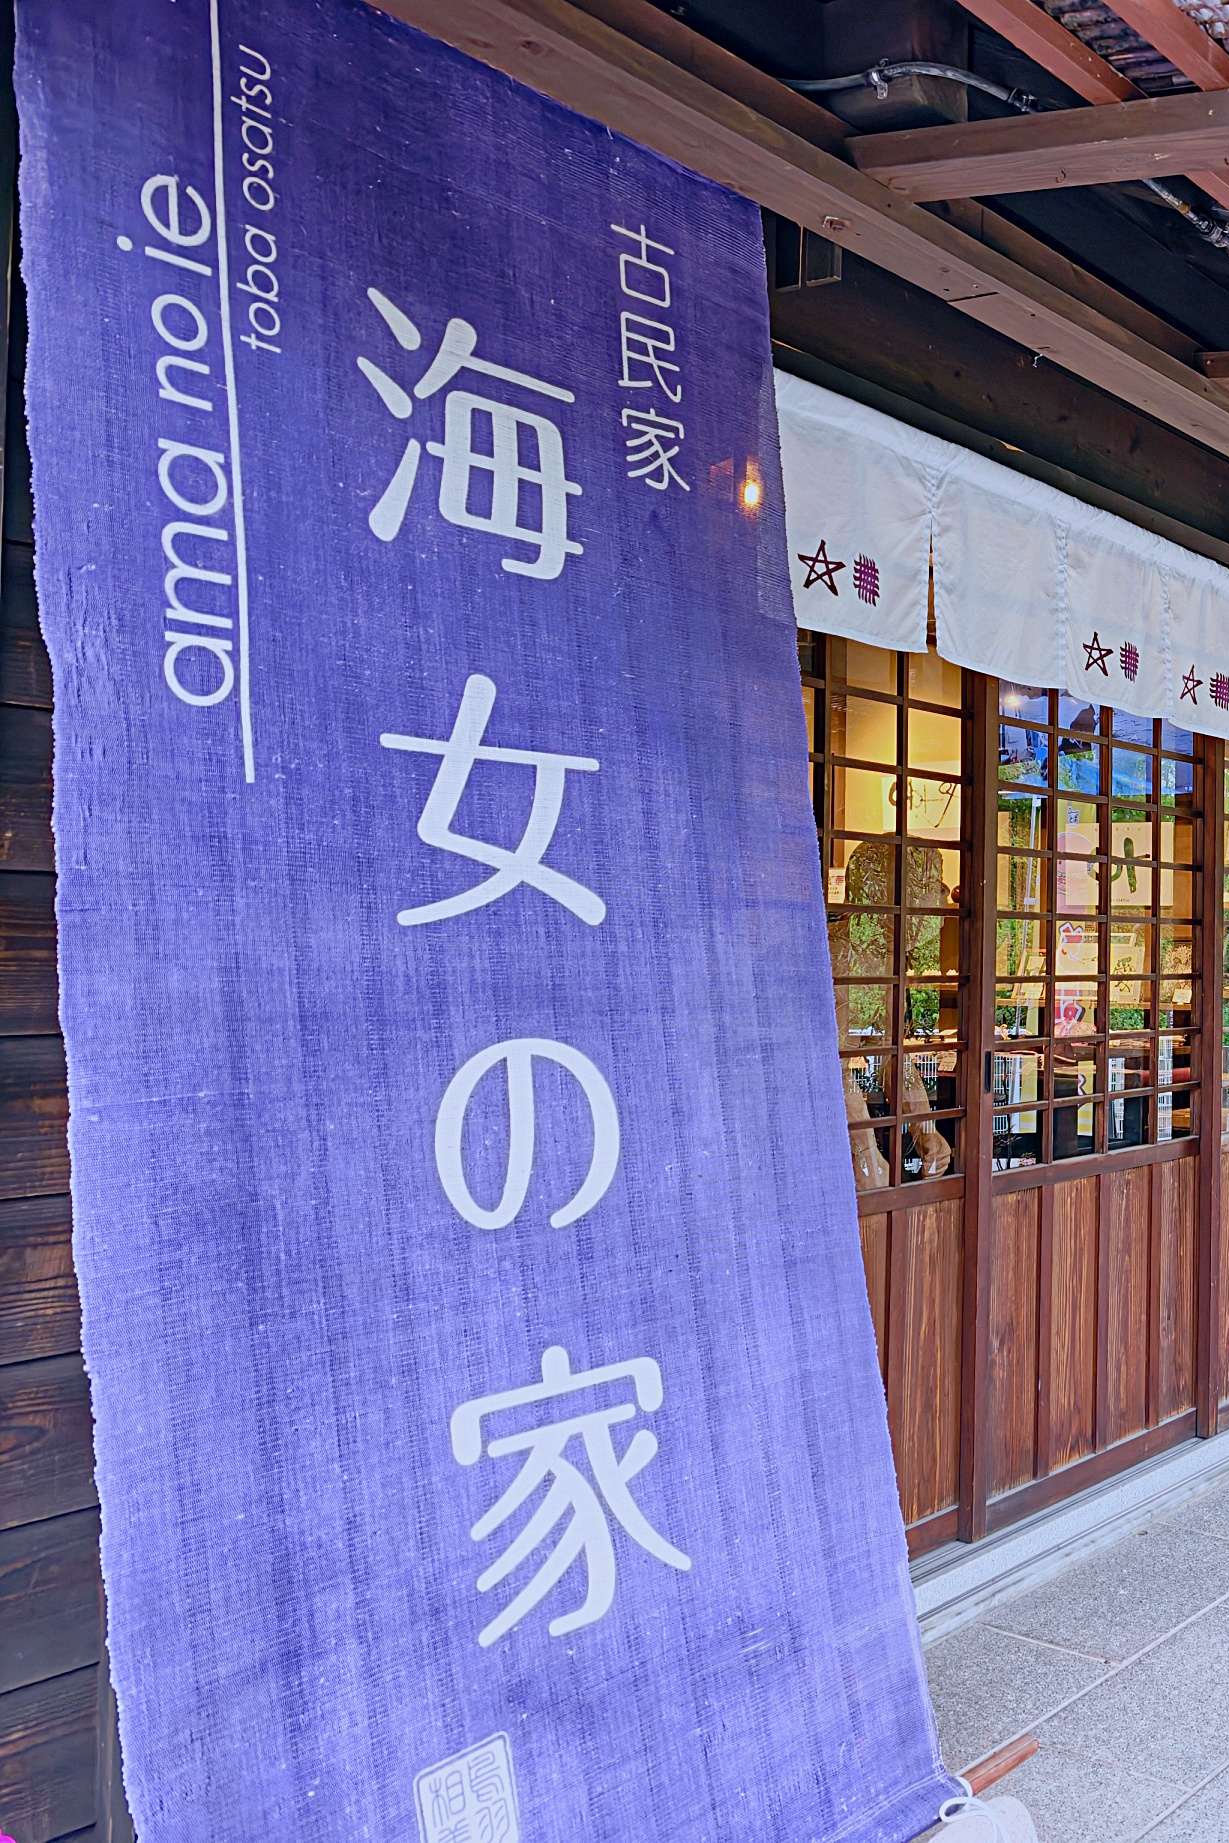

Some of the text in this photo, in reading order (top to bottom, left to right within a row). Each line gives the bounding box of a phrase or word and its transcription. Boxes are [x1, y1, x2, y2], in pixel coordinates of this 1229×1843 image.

[230, 44, 283, 355] toba osatsu
[611, 222, 691, 493] 古民家
[116, 172, 236, 708] ama no ie
[356, 286, 692, 1649] 海女の家
